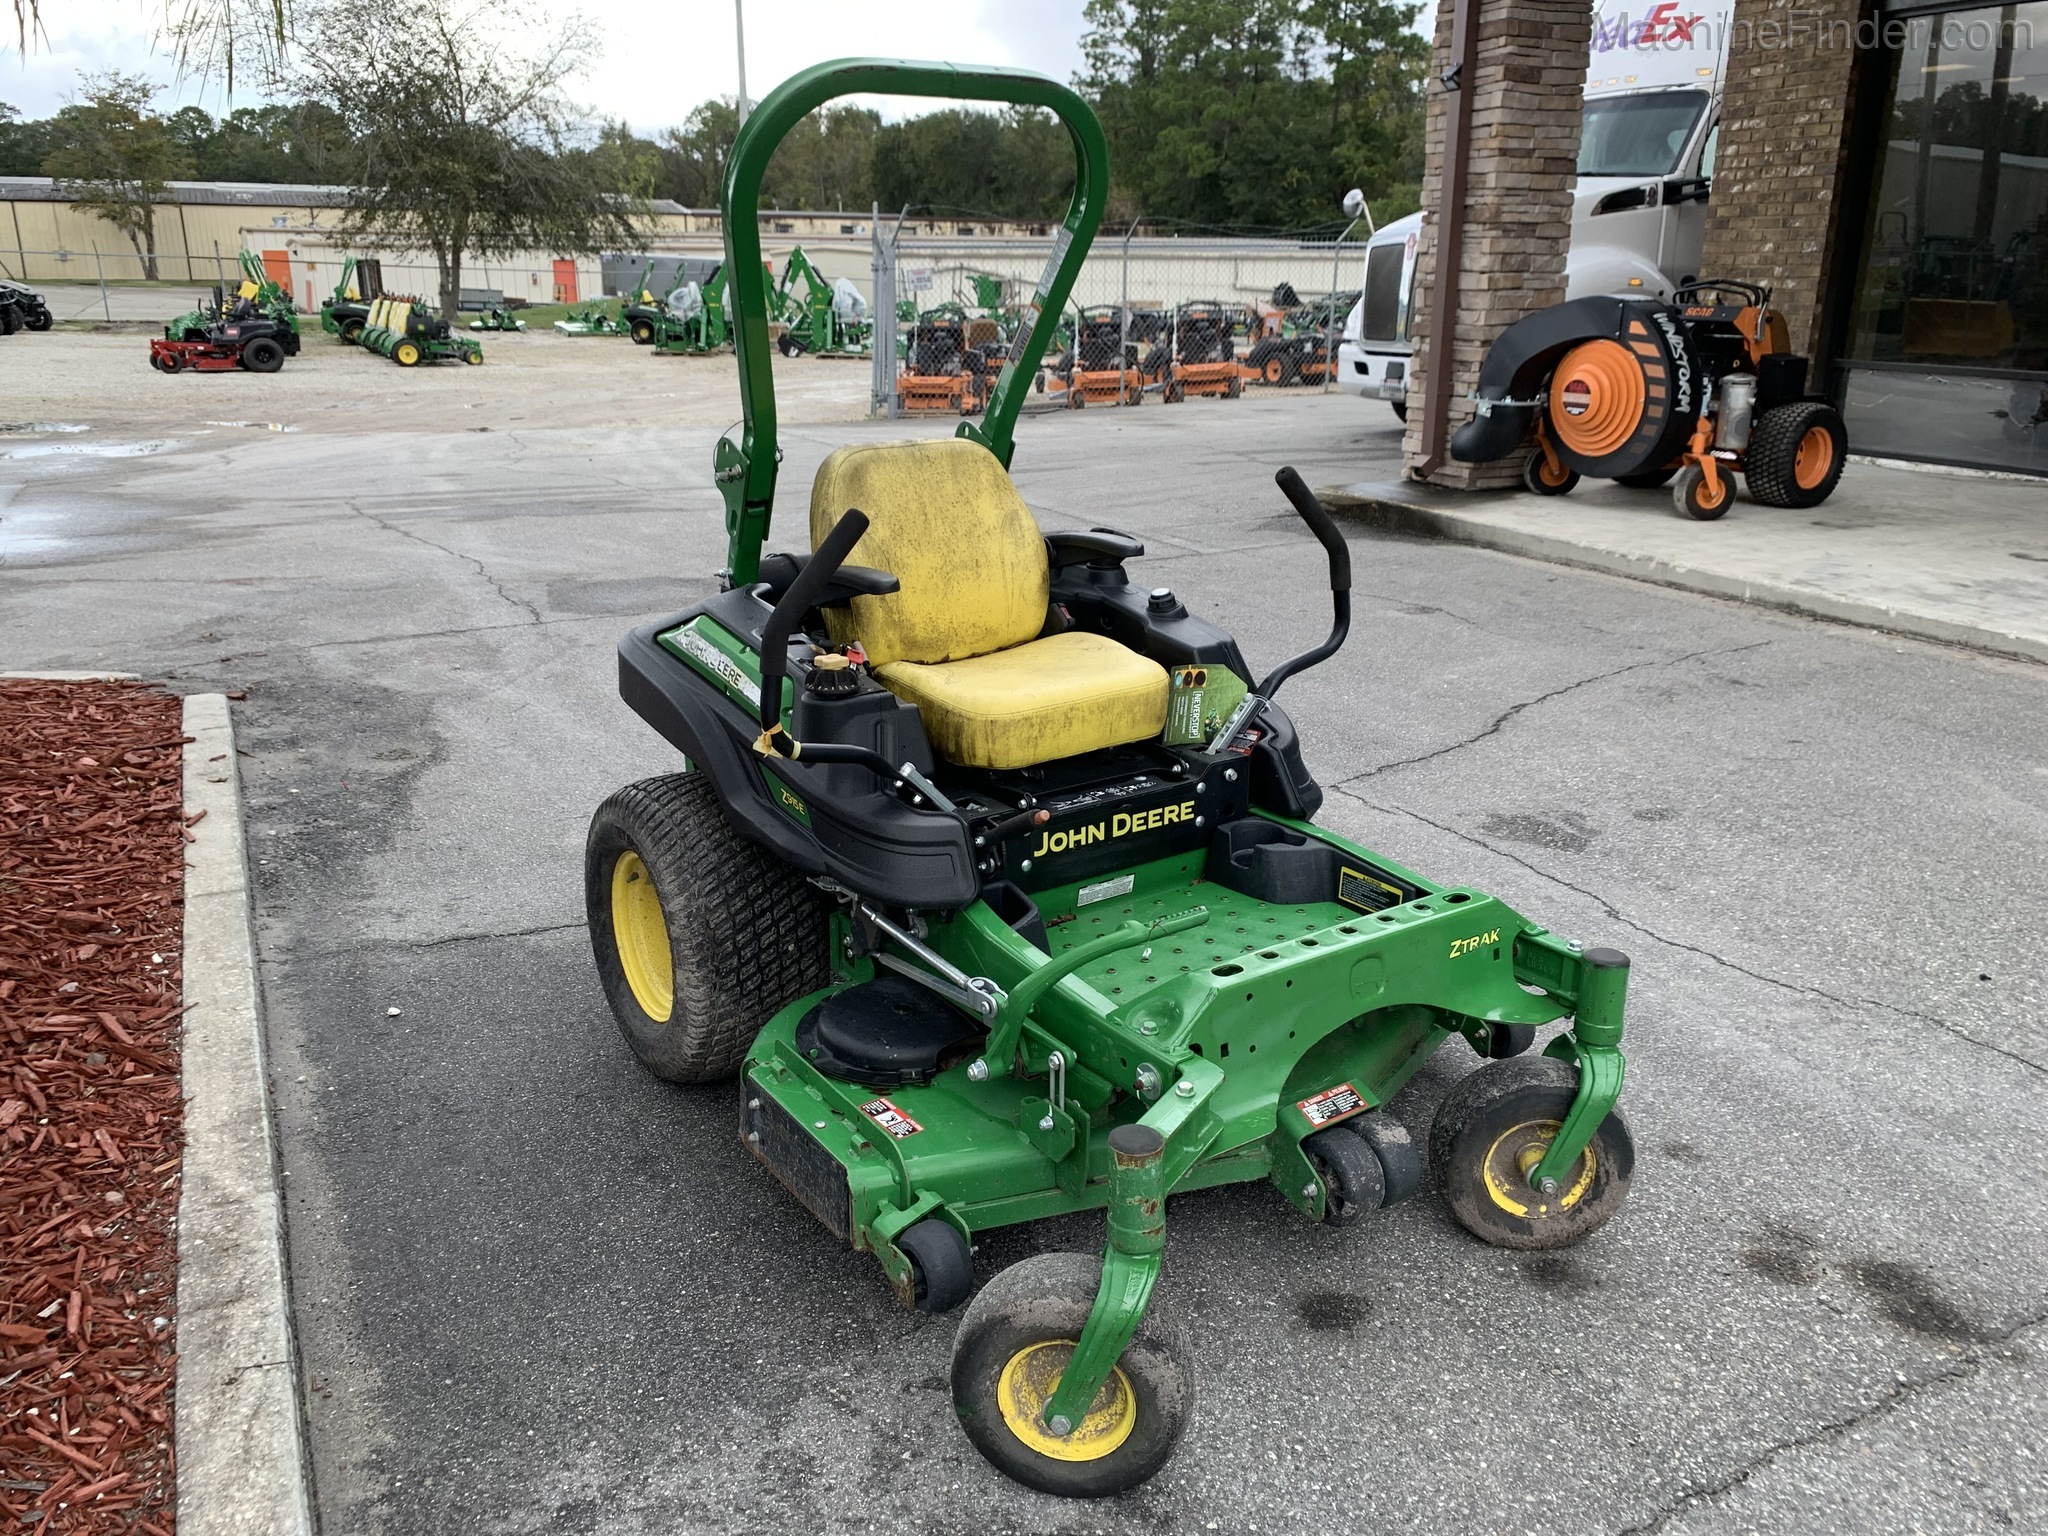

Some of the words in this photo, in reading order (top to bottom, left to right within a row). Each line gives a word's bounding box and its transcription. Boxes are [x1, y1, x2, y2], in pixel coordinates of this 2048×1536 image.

[1684, 306, 1714, 317] SCAG
[1653, 312, 1691, 413] WINDSTORM
[1034, 821, 1105, 858] JOHN
[1112, 800, 1195, 838] DEERE
[1449, 927, 1501, 959] ZTRAK
